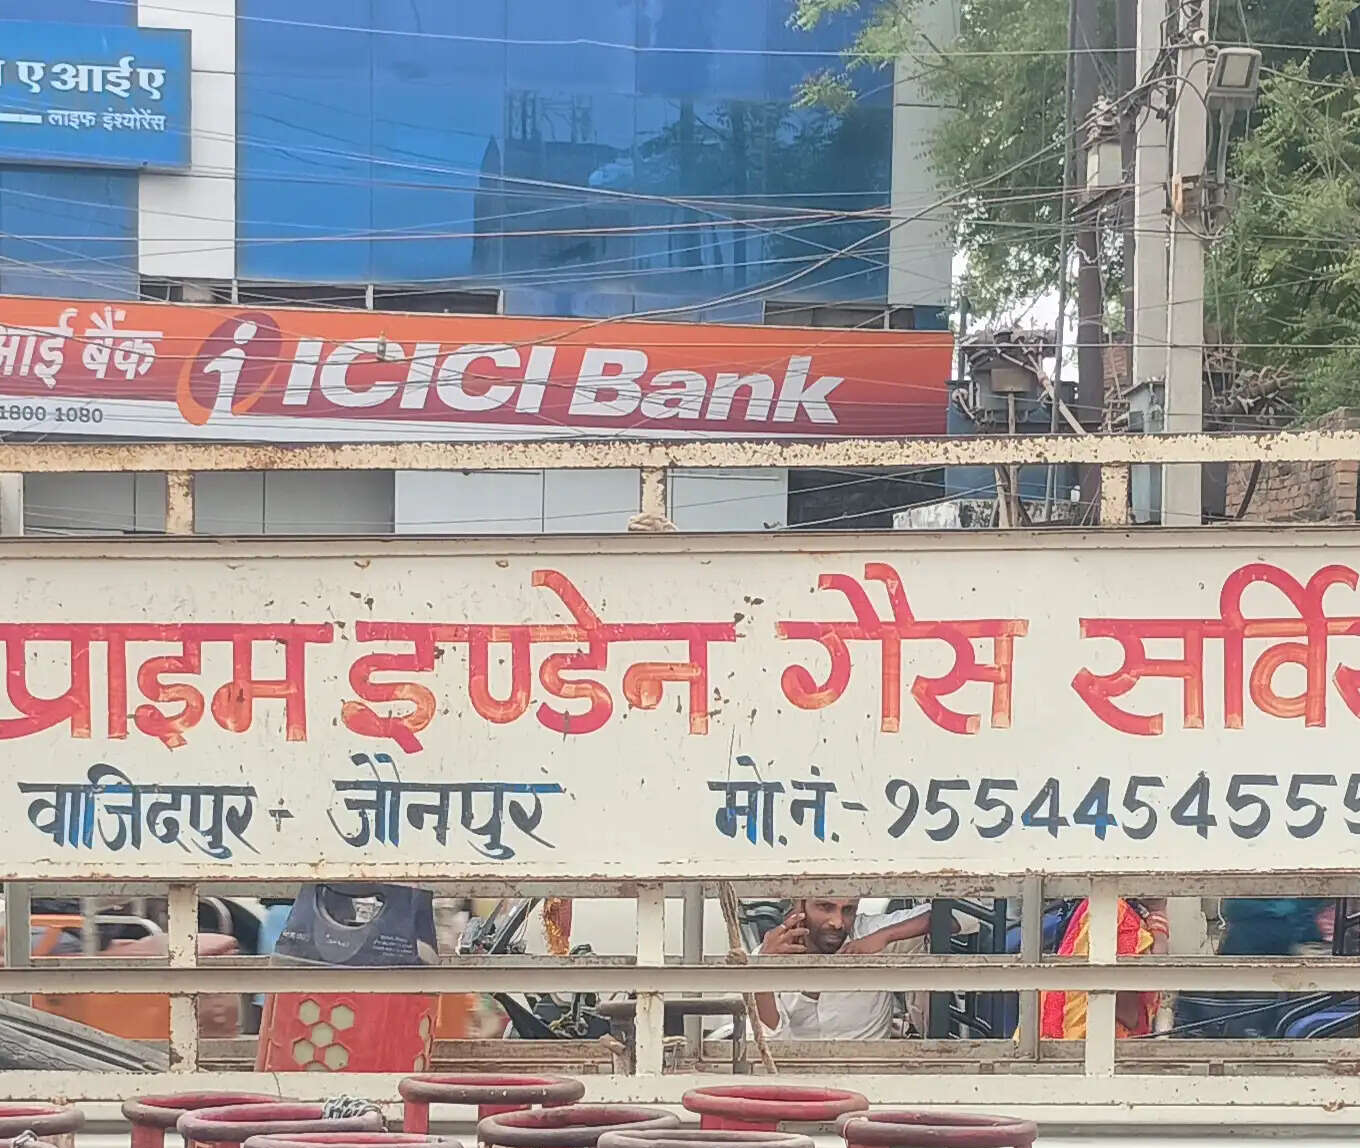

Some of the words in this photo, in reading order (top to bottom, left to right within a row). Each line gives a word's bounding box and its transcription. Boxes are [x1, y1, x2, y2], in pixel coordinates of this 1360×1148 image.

[46, 109, 96, 128] लाइफ
[82, 306, 163, 380] बैंक
[284, 337, 556, 415] ICICI
[567, 347, 845, 424] Bank
[54, 405, 103, 424] 1080
[340, 569, 736, 754] इण्डेन
[776, 561, 1028, 735] गैस
[331, 753, 571, 859] जौनपुर
